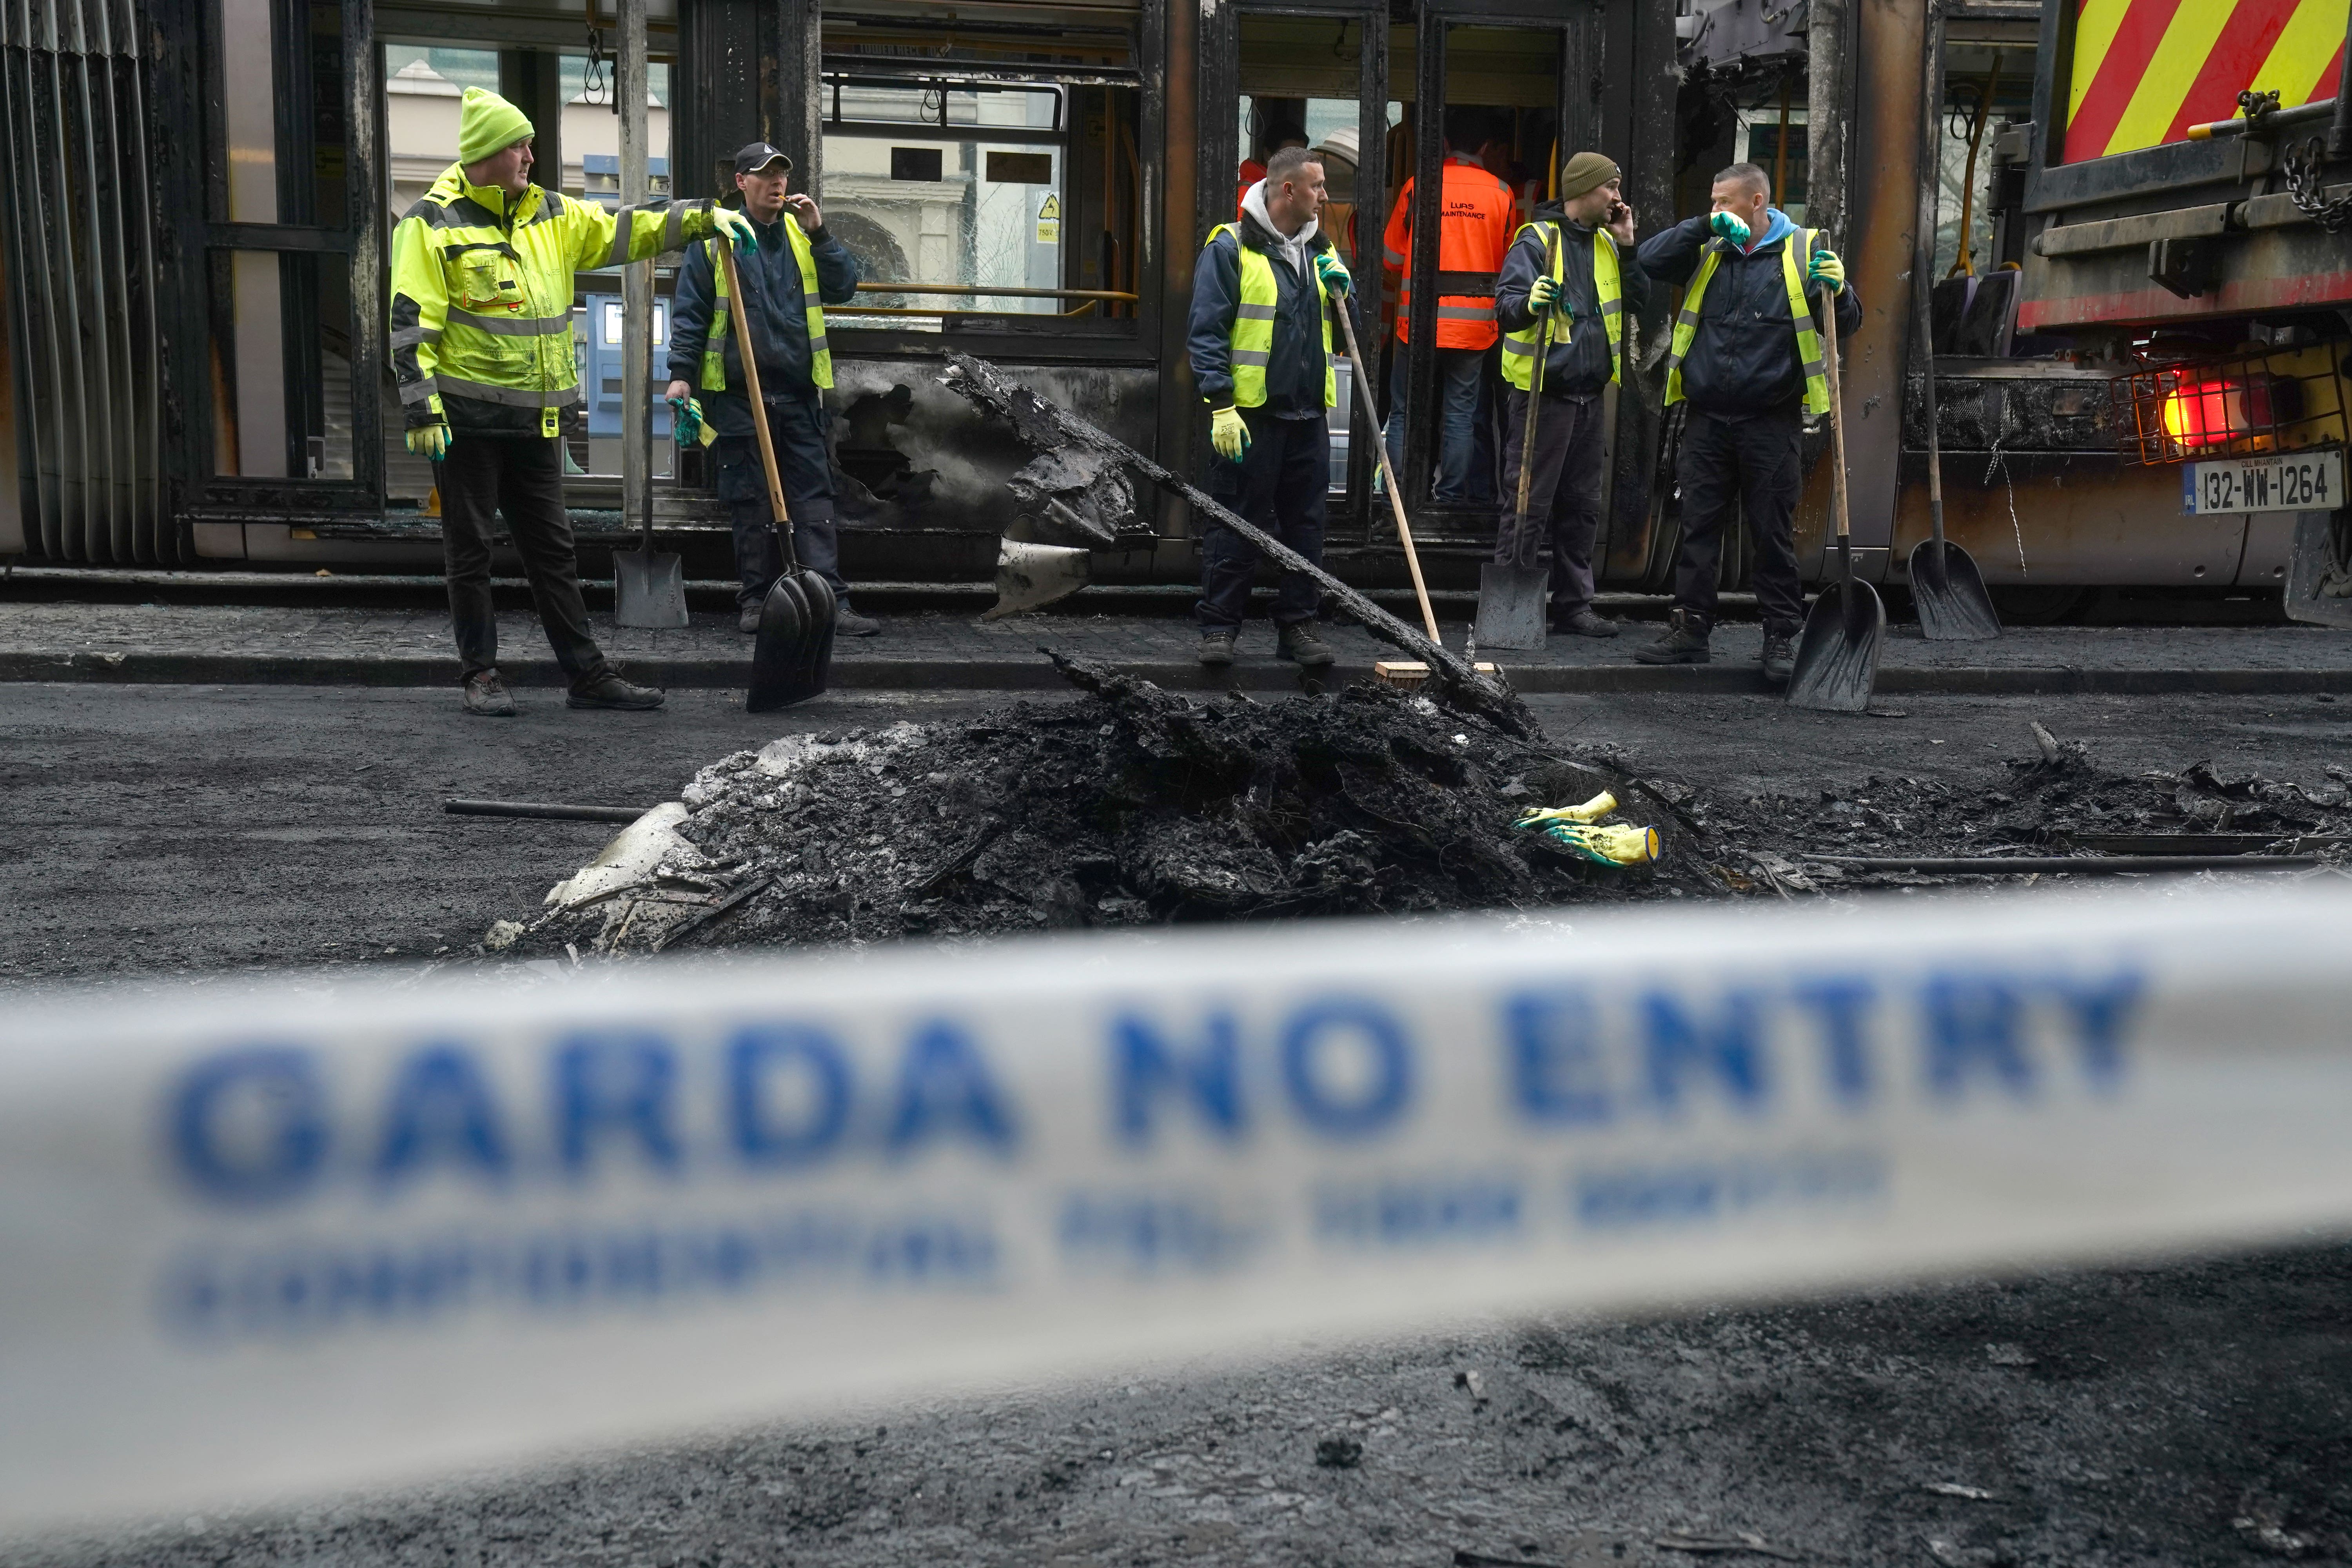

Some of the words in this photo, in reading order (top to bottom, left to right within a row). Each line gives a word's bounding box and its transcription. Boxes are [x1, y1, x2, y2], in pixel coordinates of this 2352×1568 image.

[1450, 201, 1474, 210] LUAS
[1441, 211, 1486, 220] MAINTENANCE
[2204, 463, 2328, 510] 132-WW-1264
[2185, 494, 2195, 506] IRL
[165, 1015, 1021, 1207] GARDA
[1106, 992, 1417, 1149] NO
[1505, 955, 2146, 1129] ENTRY
